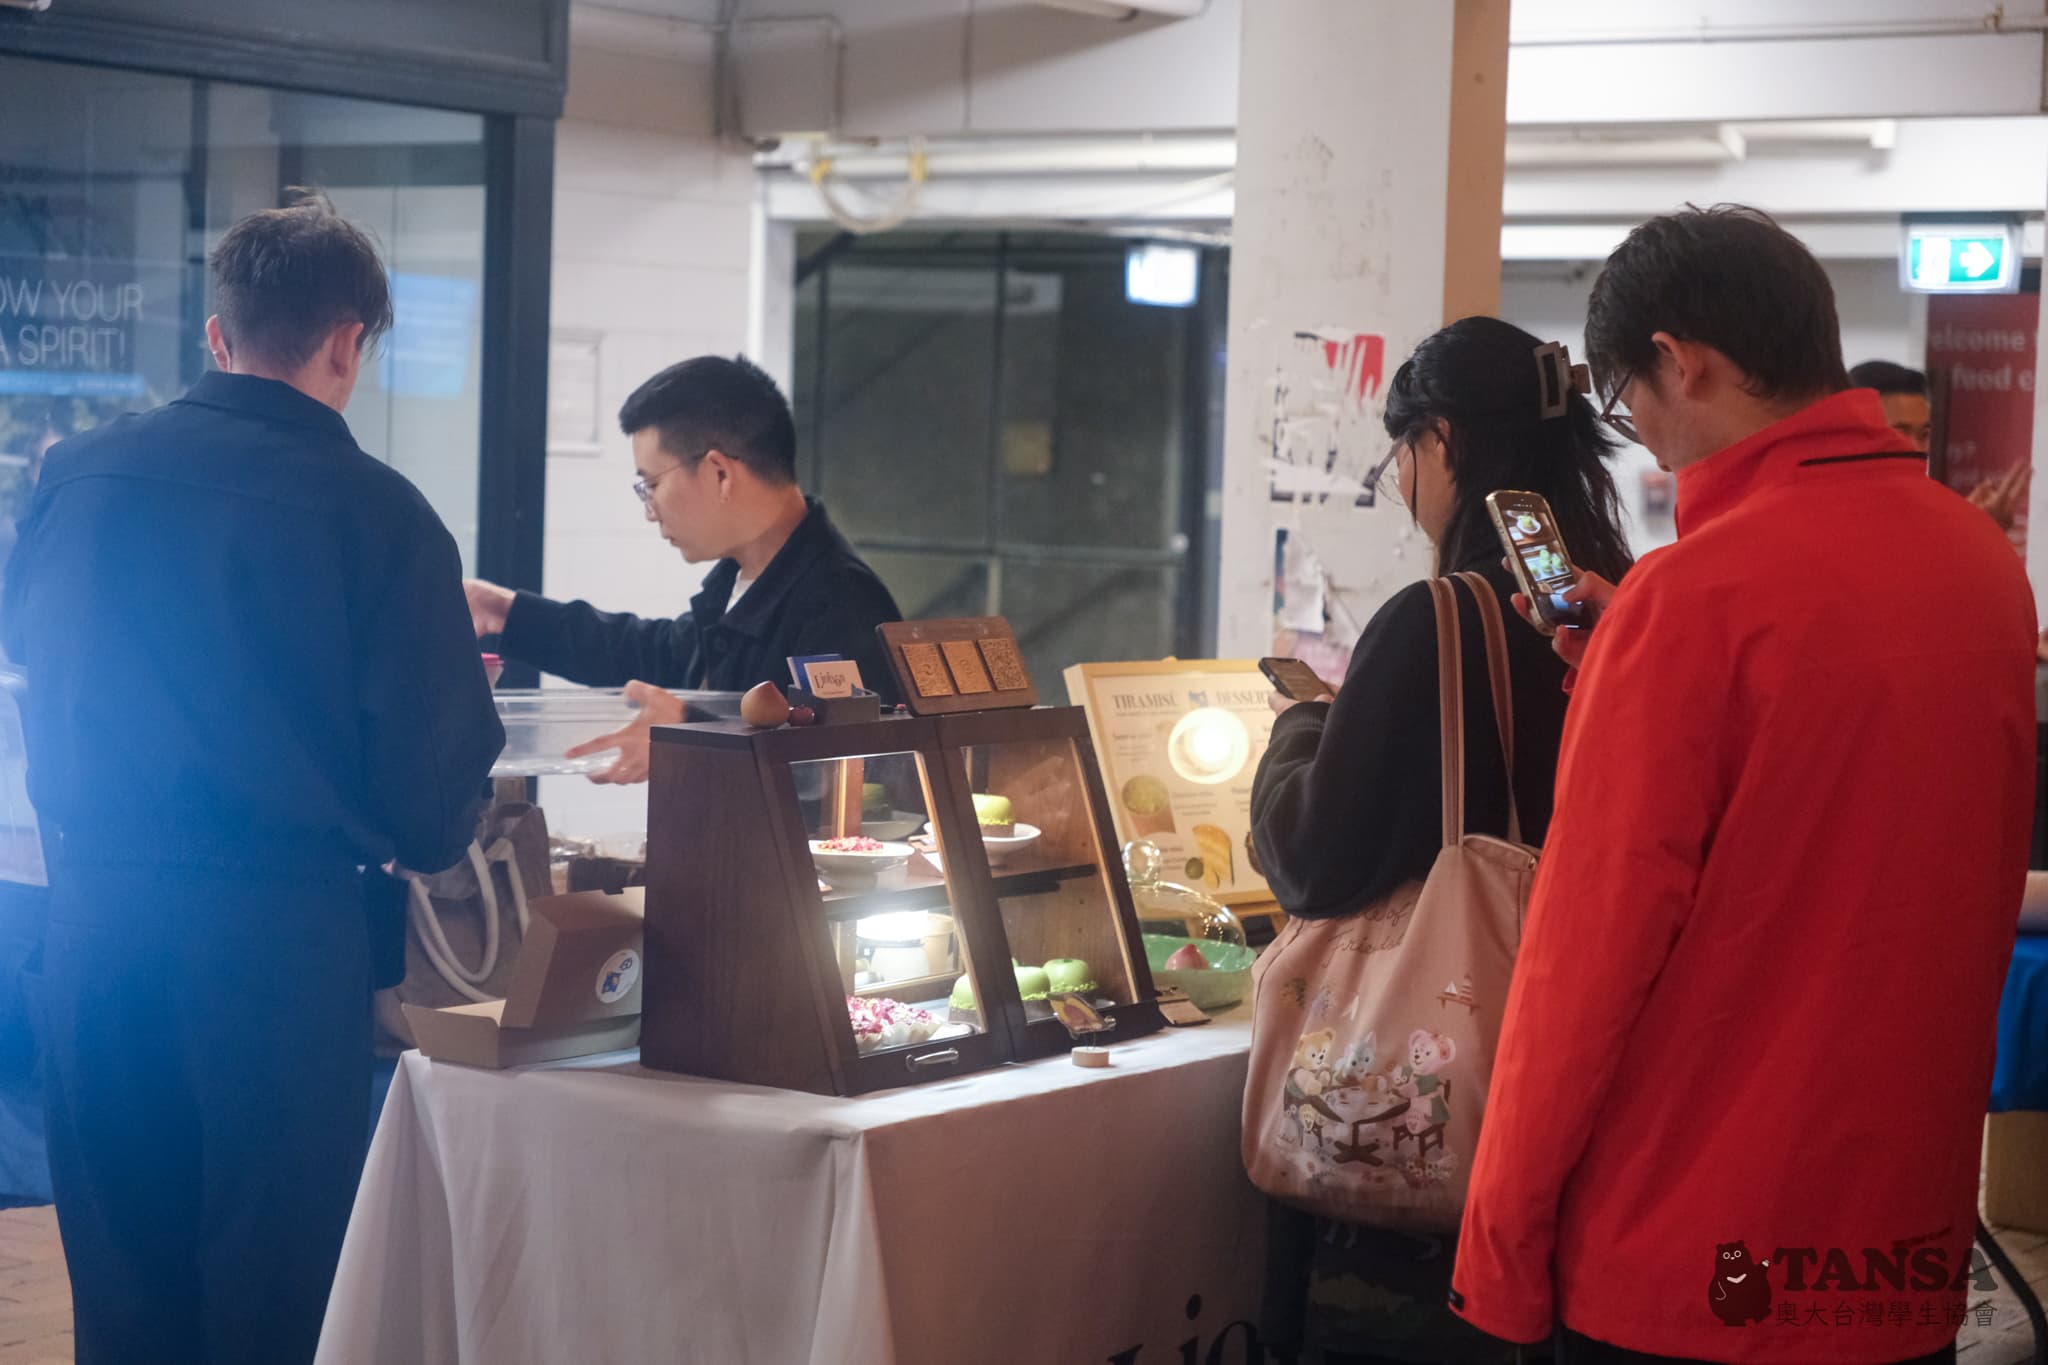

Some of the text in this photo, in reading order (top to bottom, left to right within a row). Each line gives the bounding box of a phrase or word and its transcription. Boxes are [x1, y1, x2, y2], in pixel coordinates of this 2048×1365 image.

[0, 275, 145, 322] W YOUR
[18, 324, 126, 368] SPIRIT!
[1950, 360, 2012, 392] food
